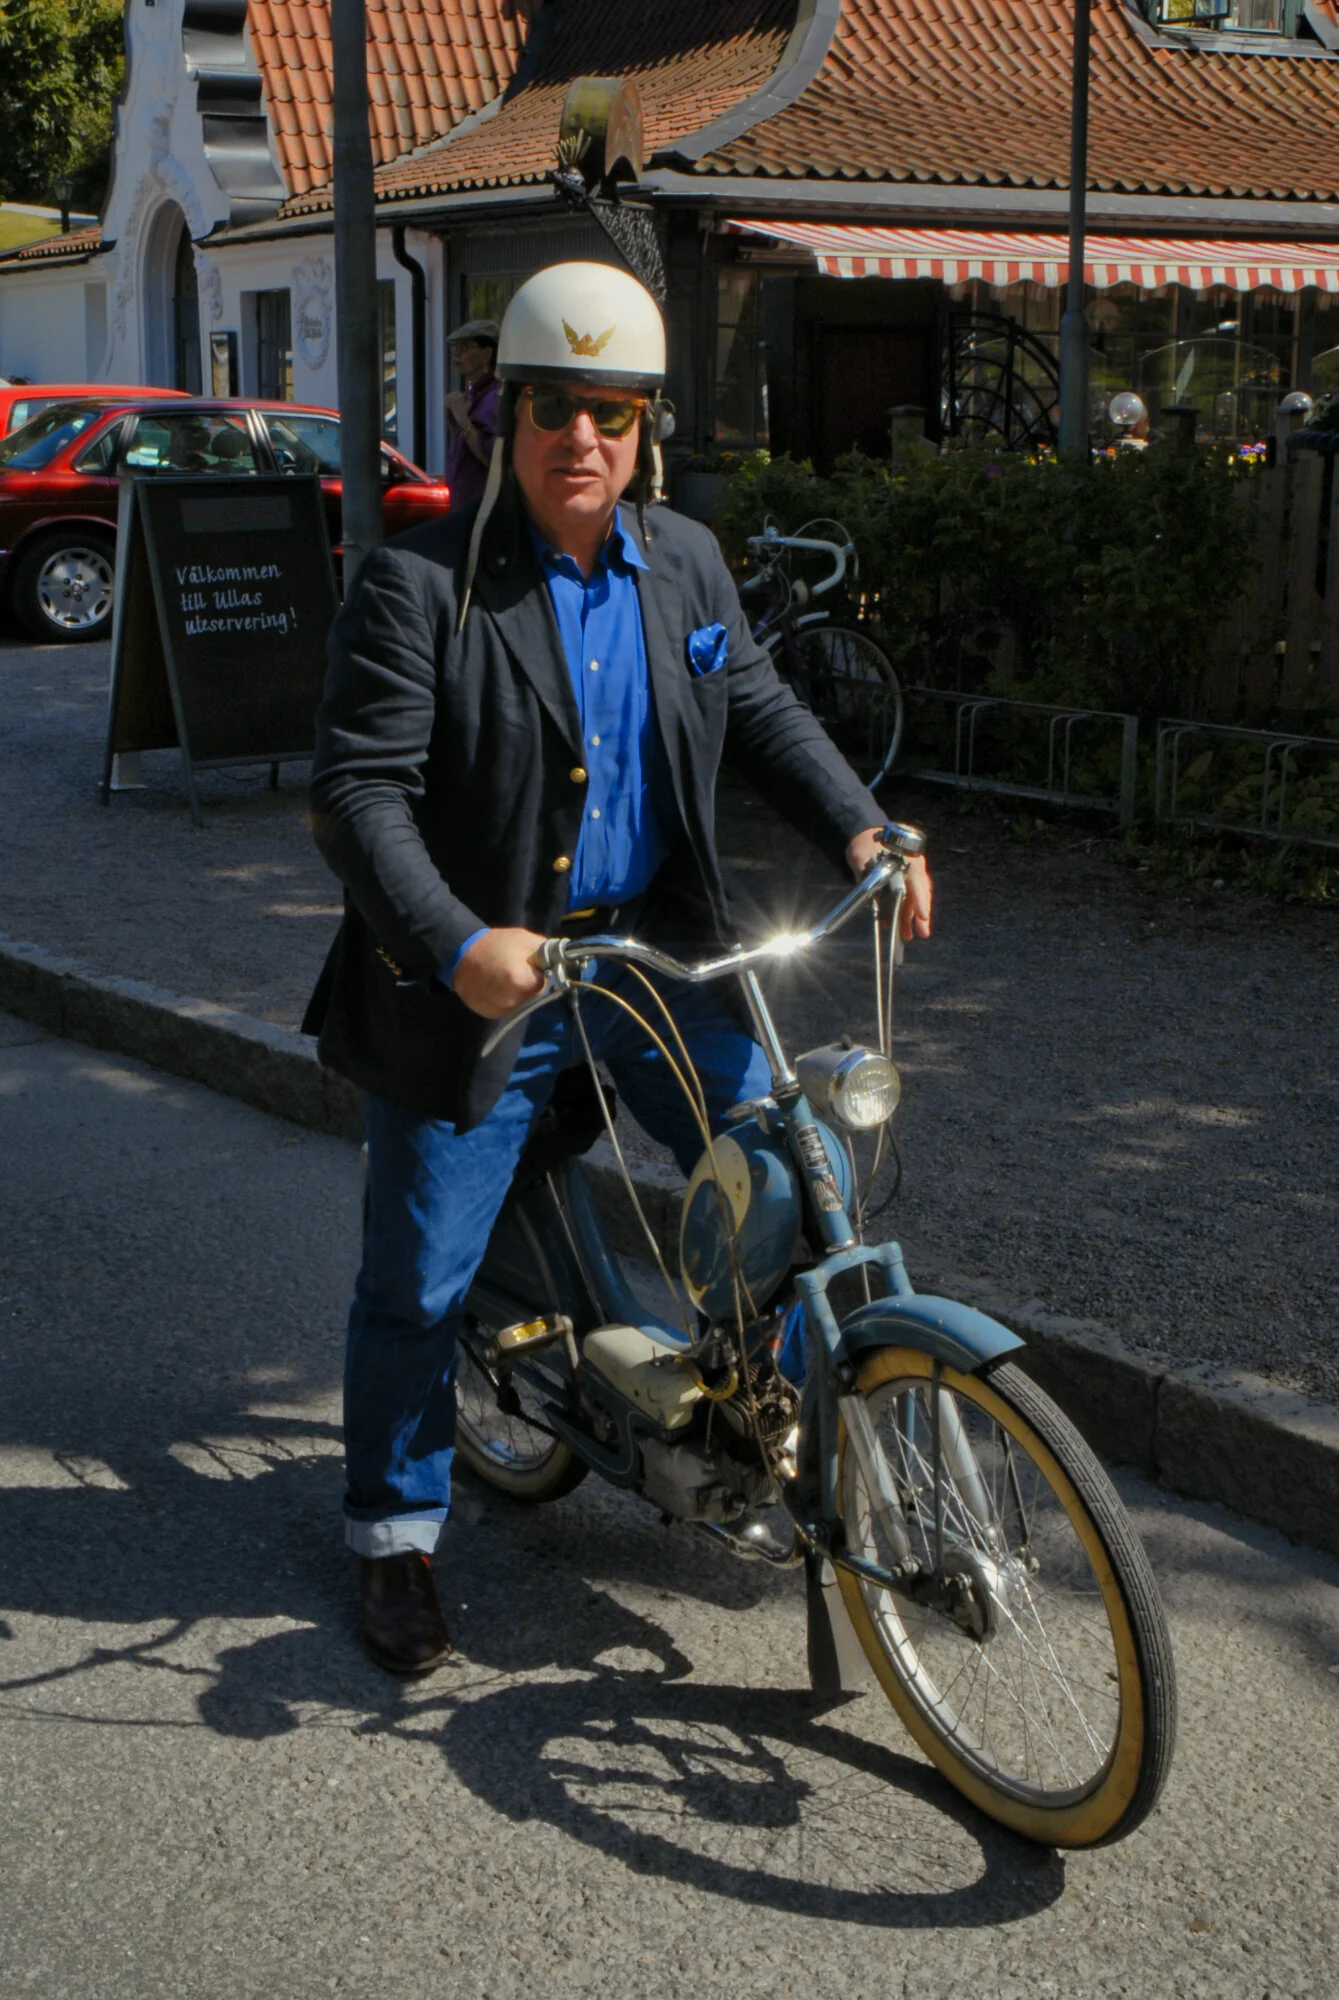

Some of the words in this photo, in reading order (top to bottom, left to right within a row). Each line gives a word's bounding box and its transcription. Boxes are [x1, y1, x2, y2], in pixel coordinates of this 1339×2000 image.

[176, 564, 282, 585] Välkommen
[181, 592, 207, 611] till
[212, 588, 263, 609] Ullas
[185, 606, 298, 635] uteservering!
